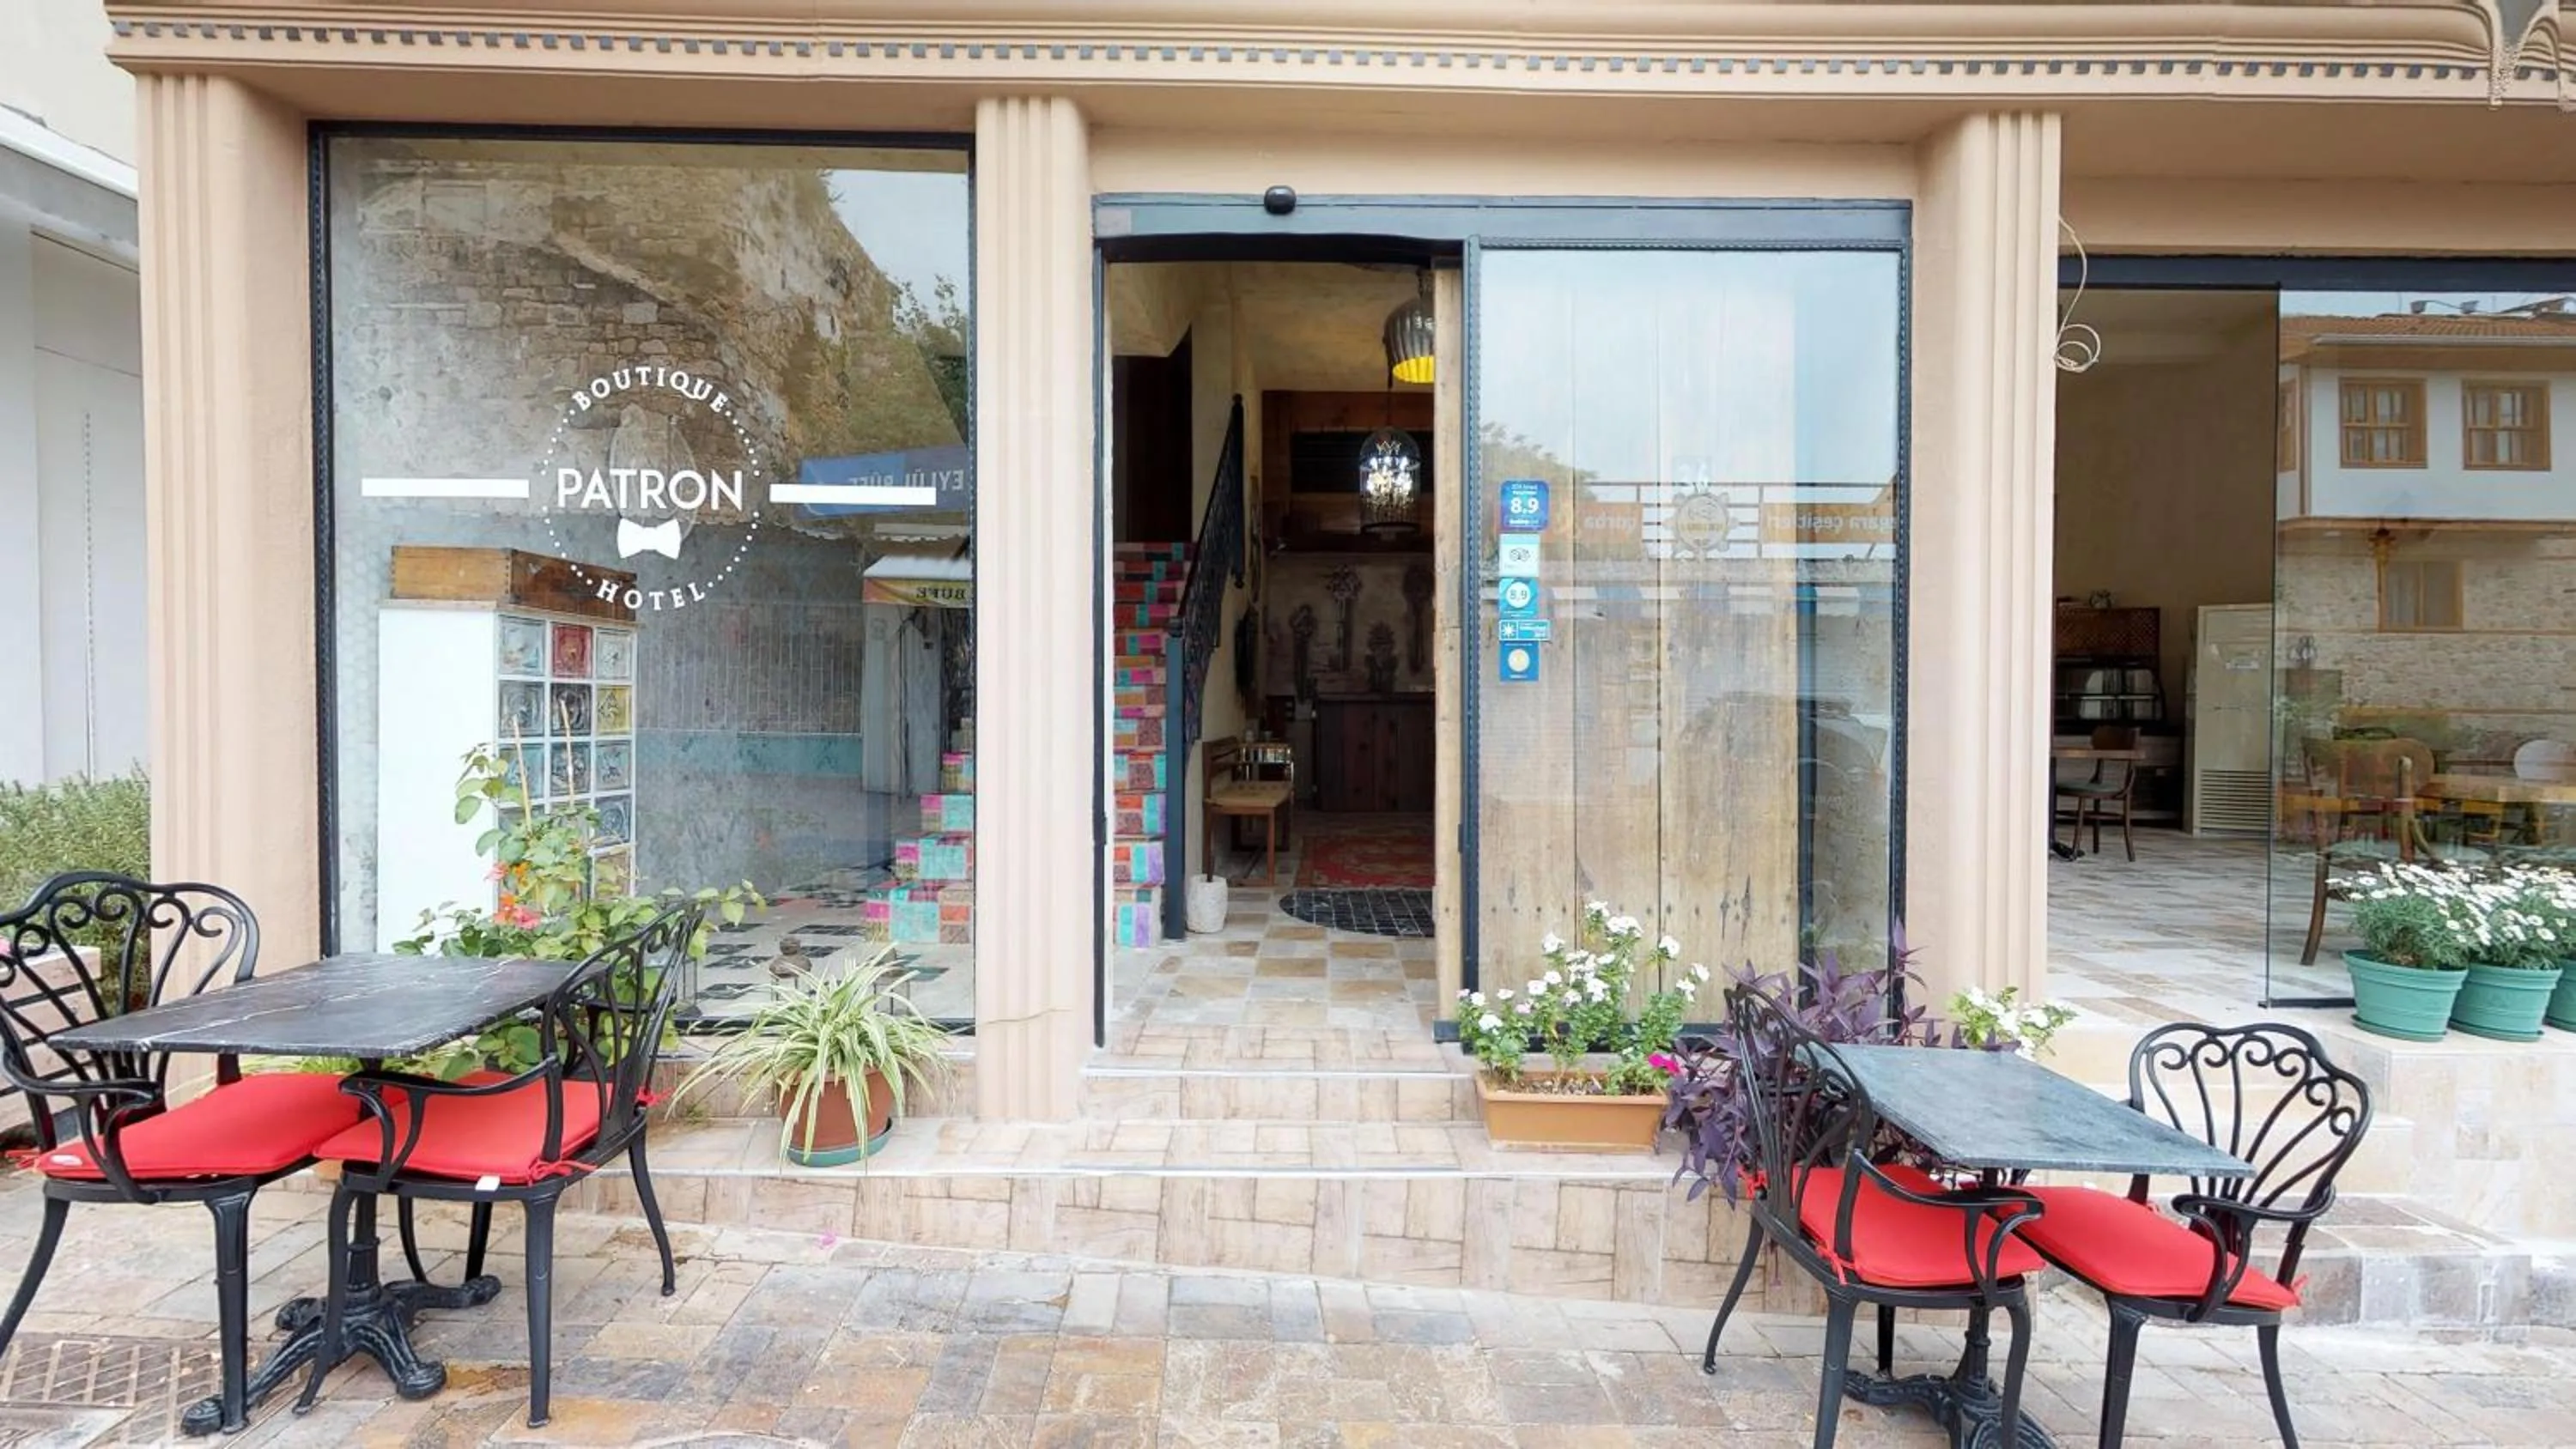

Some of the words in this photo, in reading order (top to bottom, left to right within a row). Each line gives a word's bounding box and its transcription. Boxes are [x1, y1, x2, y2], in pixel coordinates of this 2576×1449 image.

[572, 367, 729, 412] BOUTIQUE
[557, 466, 743, 512] PATRON
[595, 579, 706, 611] HOTEL
